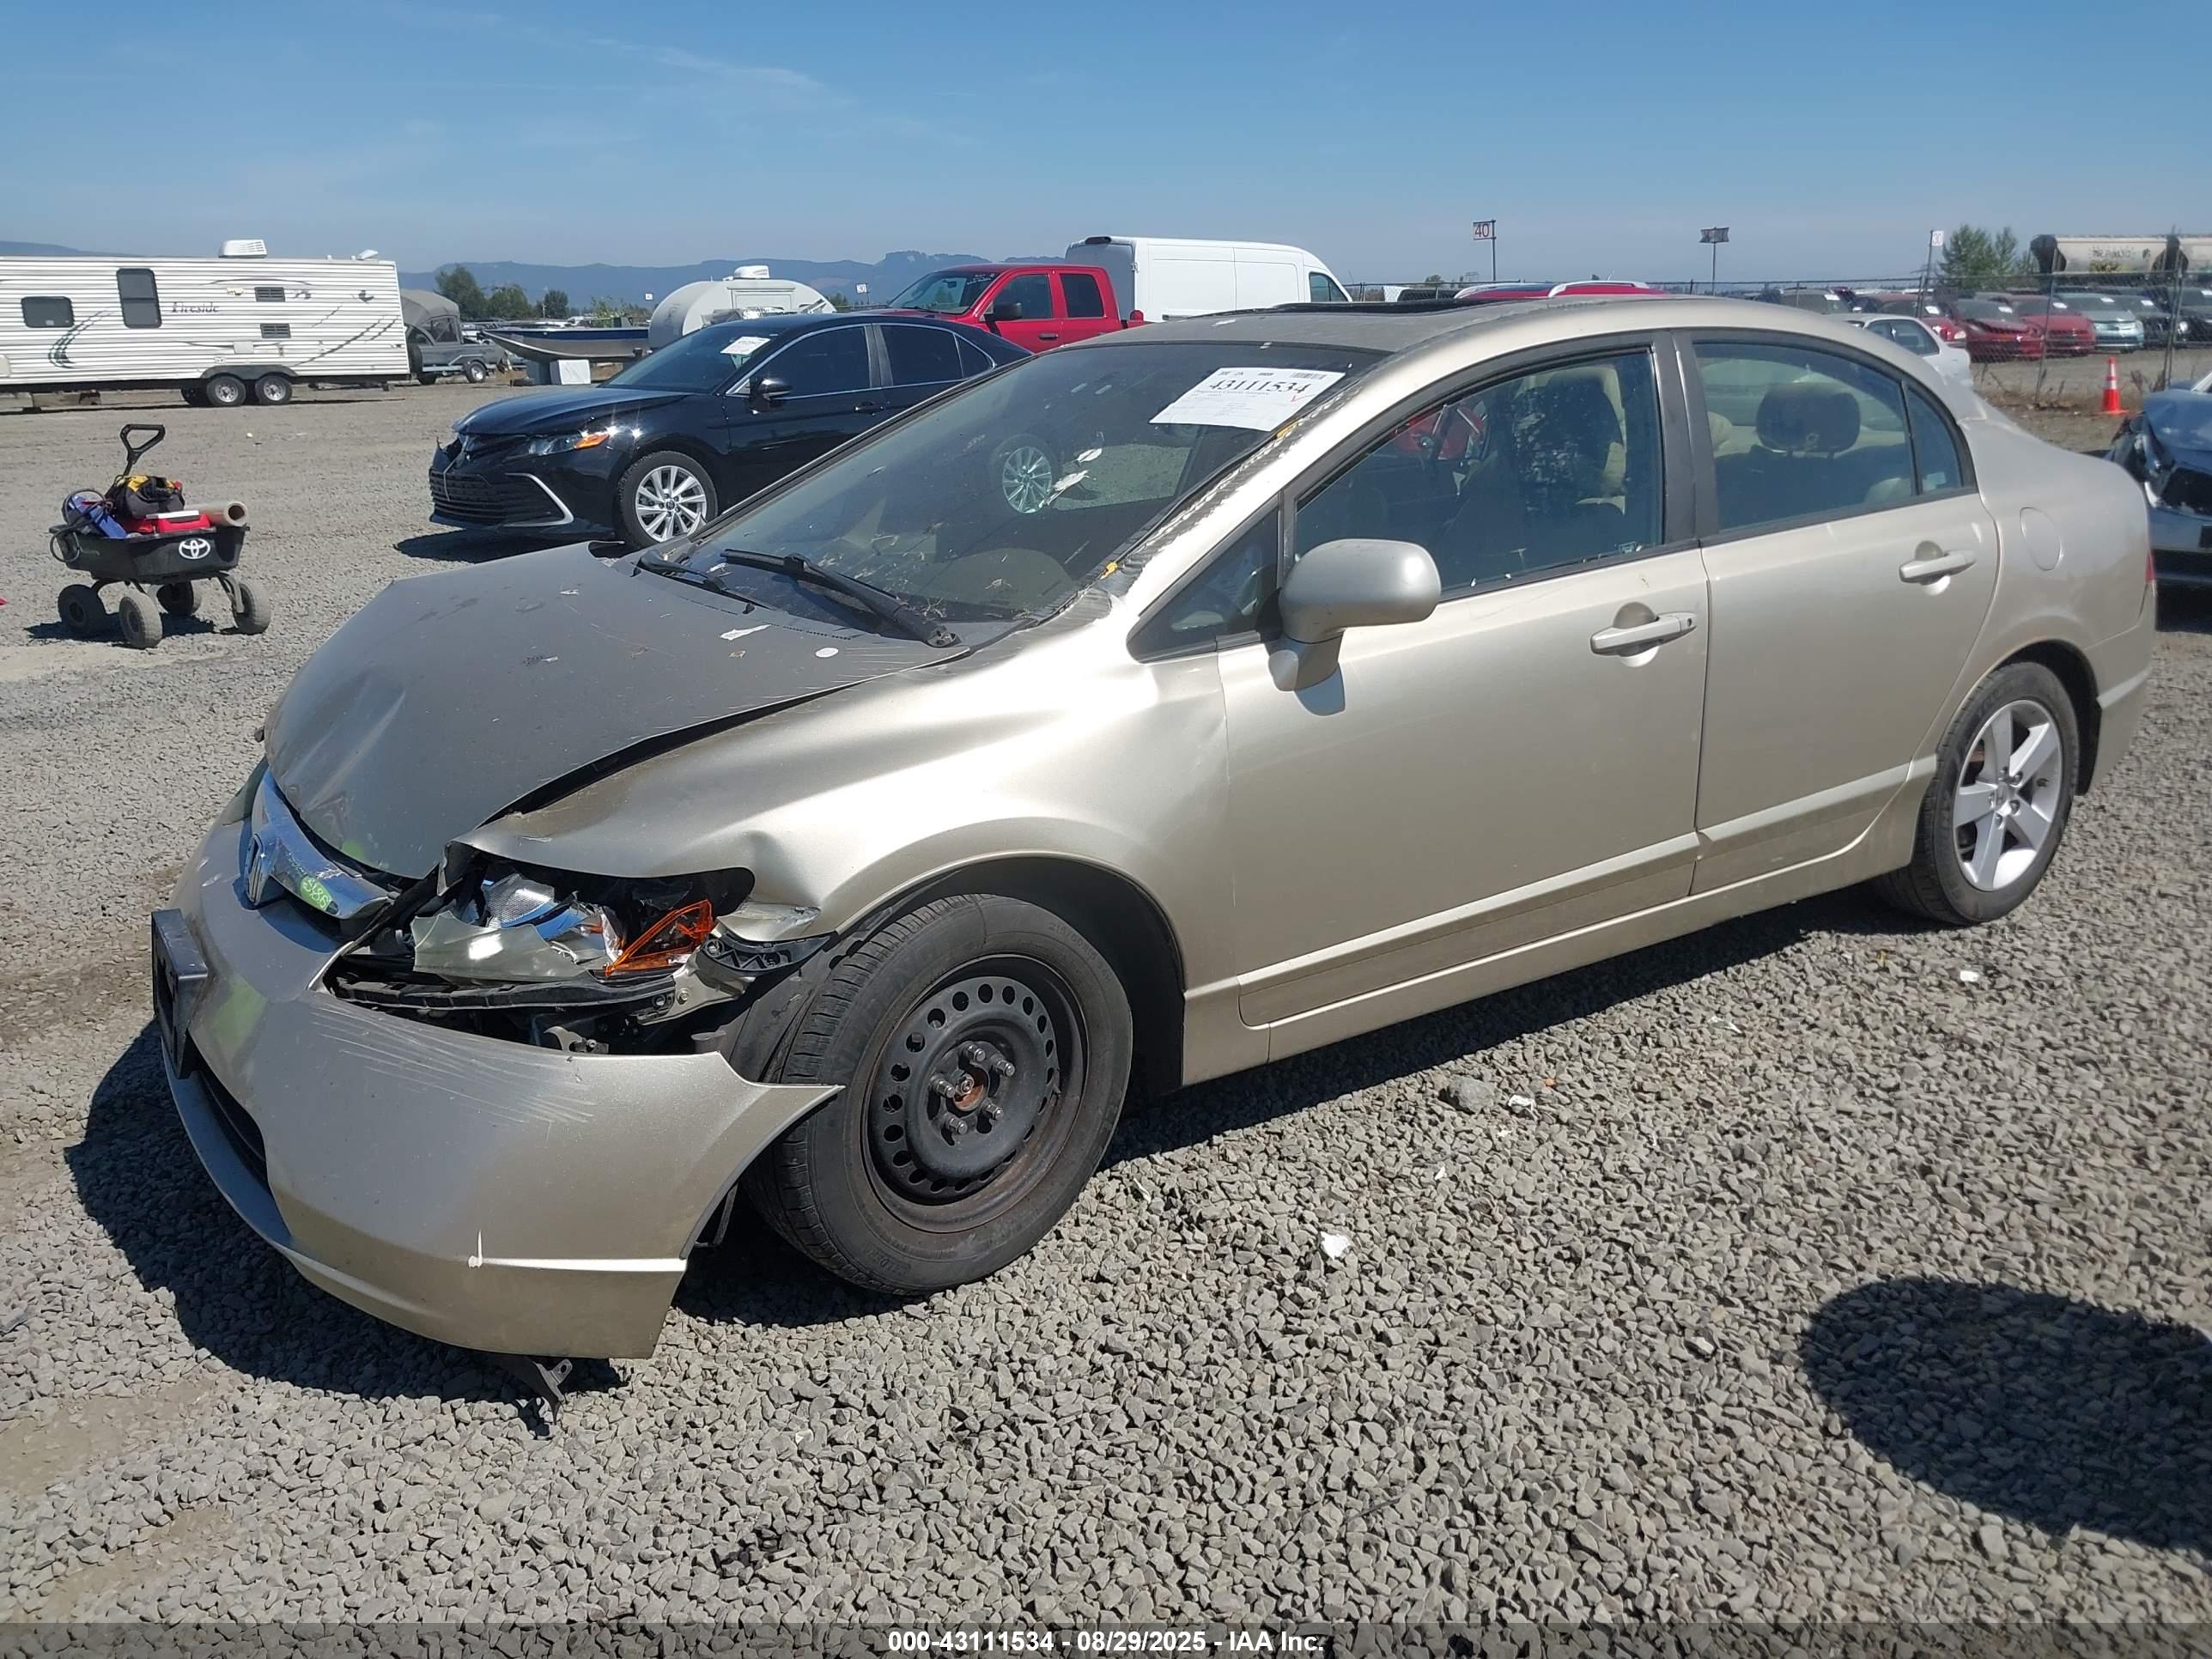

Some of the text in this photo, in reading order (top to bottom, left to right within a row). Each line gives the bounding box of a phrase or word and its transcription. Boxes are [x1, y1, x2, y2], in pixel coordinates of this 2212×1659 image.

[1474, 223, 1490, 238] 40
[171, 301, 220, 313] Fireside
[1208, 379, 1312, 393] 43111534
